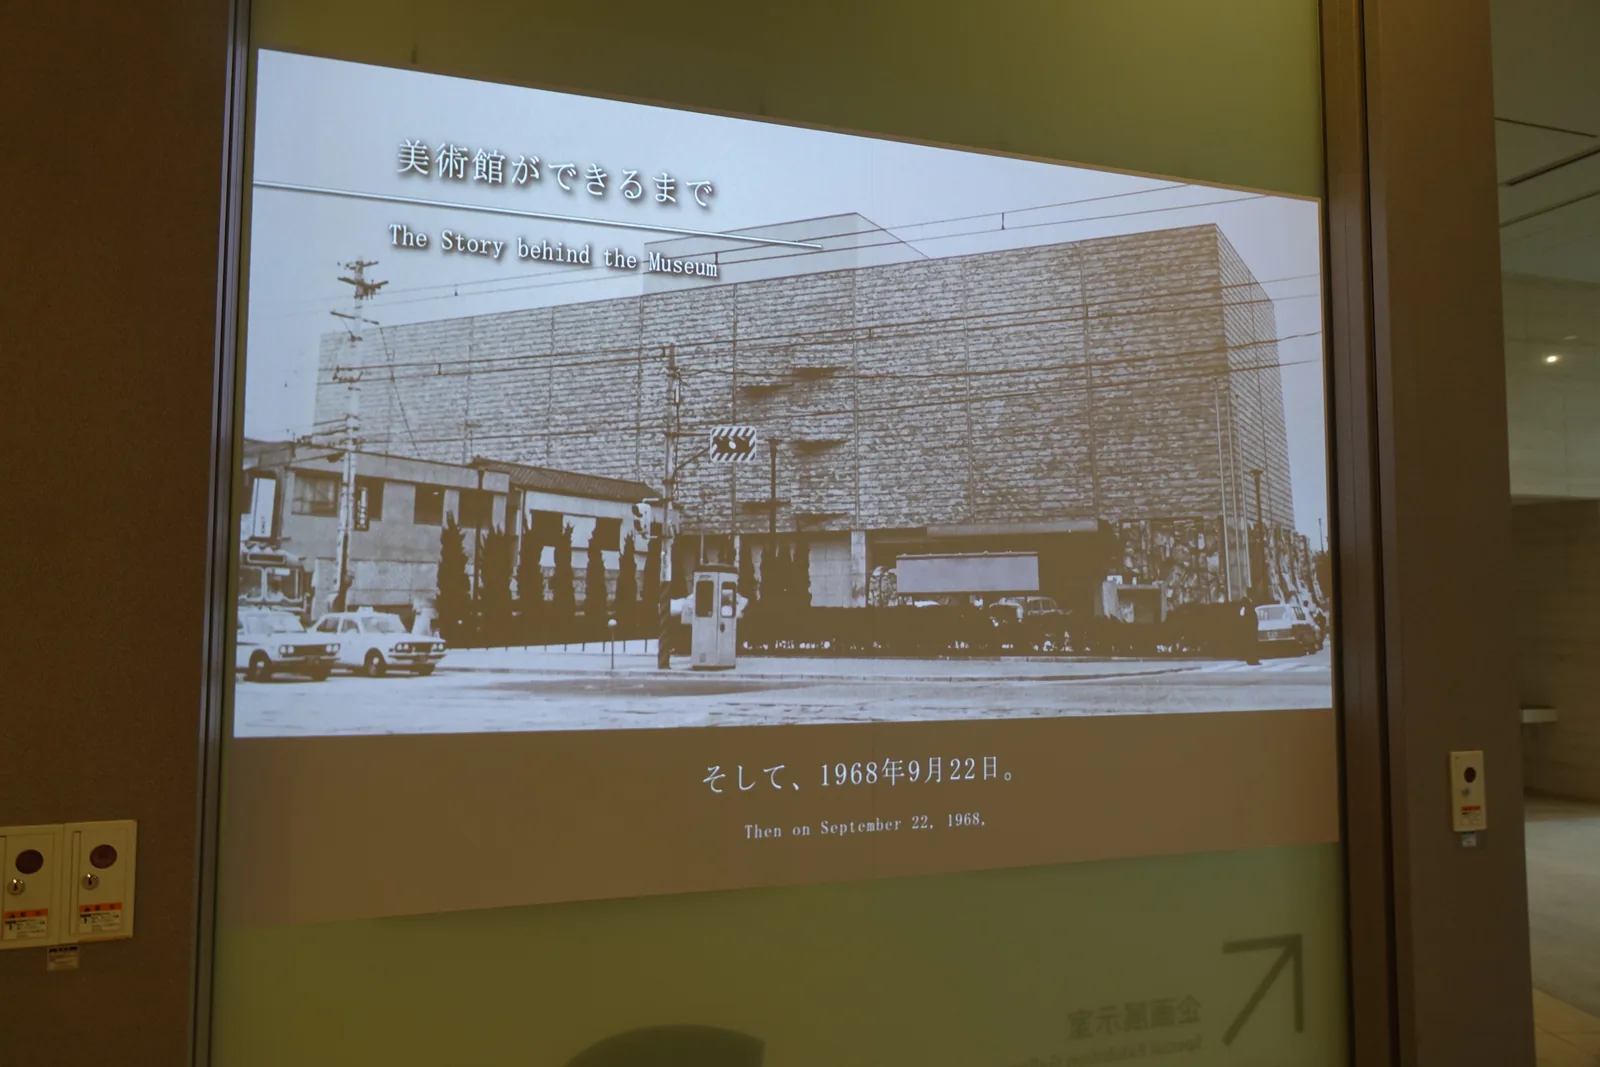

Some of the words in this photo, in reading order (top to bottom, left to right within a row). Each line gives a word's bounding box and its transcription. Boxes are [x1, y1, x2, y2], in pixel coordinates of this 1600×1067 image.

[397, 138, 713, 207] 美術館ができるまで
[389, 223, 427, 247] The
[441, 229, 504, 259] Story
[517, 237, 590, 264] behind
[604, 247, 637, 268] the
[648, 251, 718, 277] Museum
[702, 755, 1012, 793] そして、1968年9月22日。
[744, 823, 782, 839] Then
[792, 825, 811, 836] on
[820, 817, 902, 837] September
